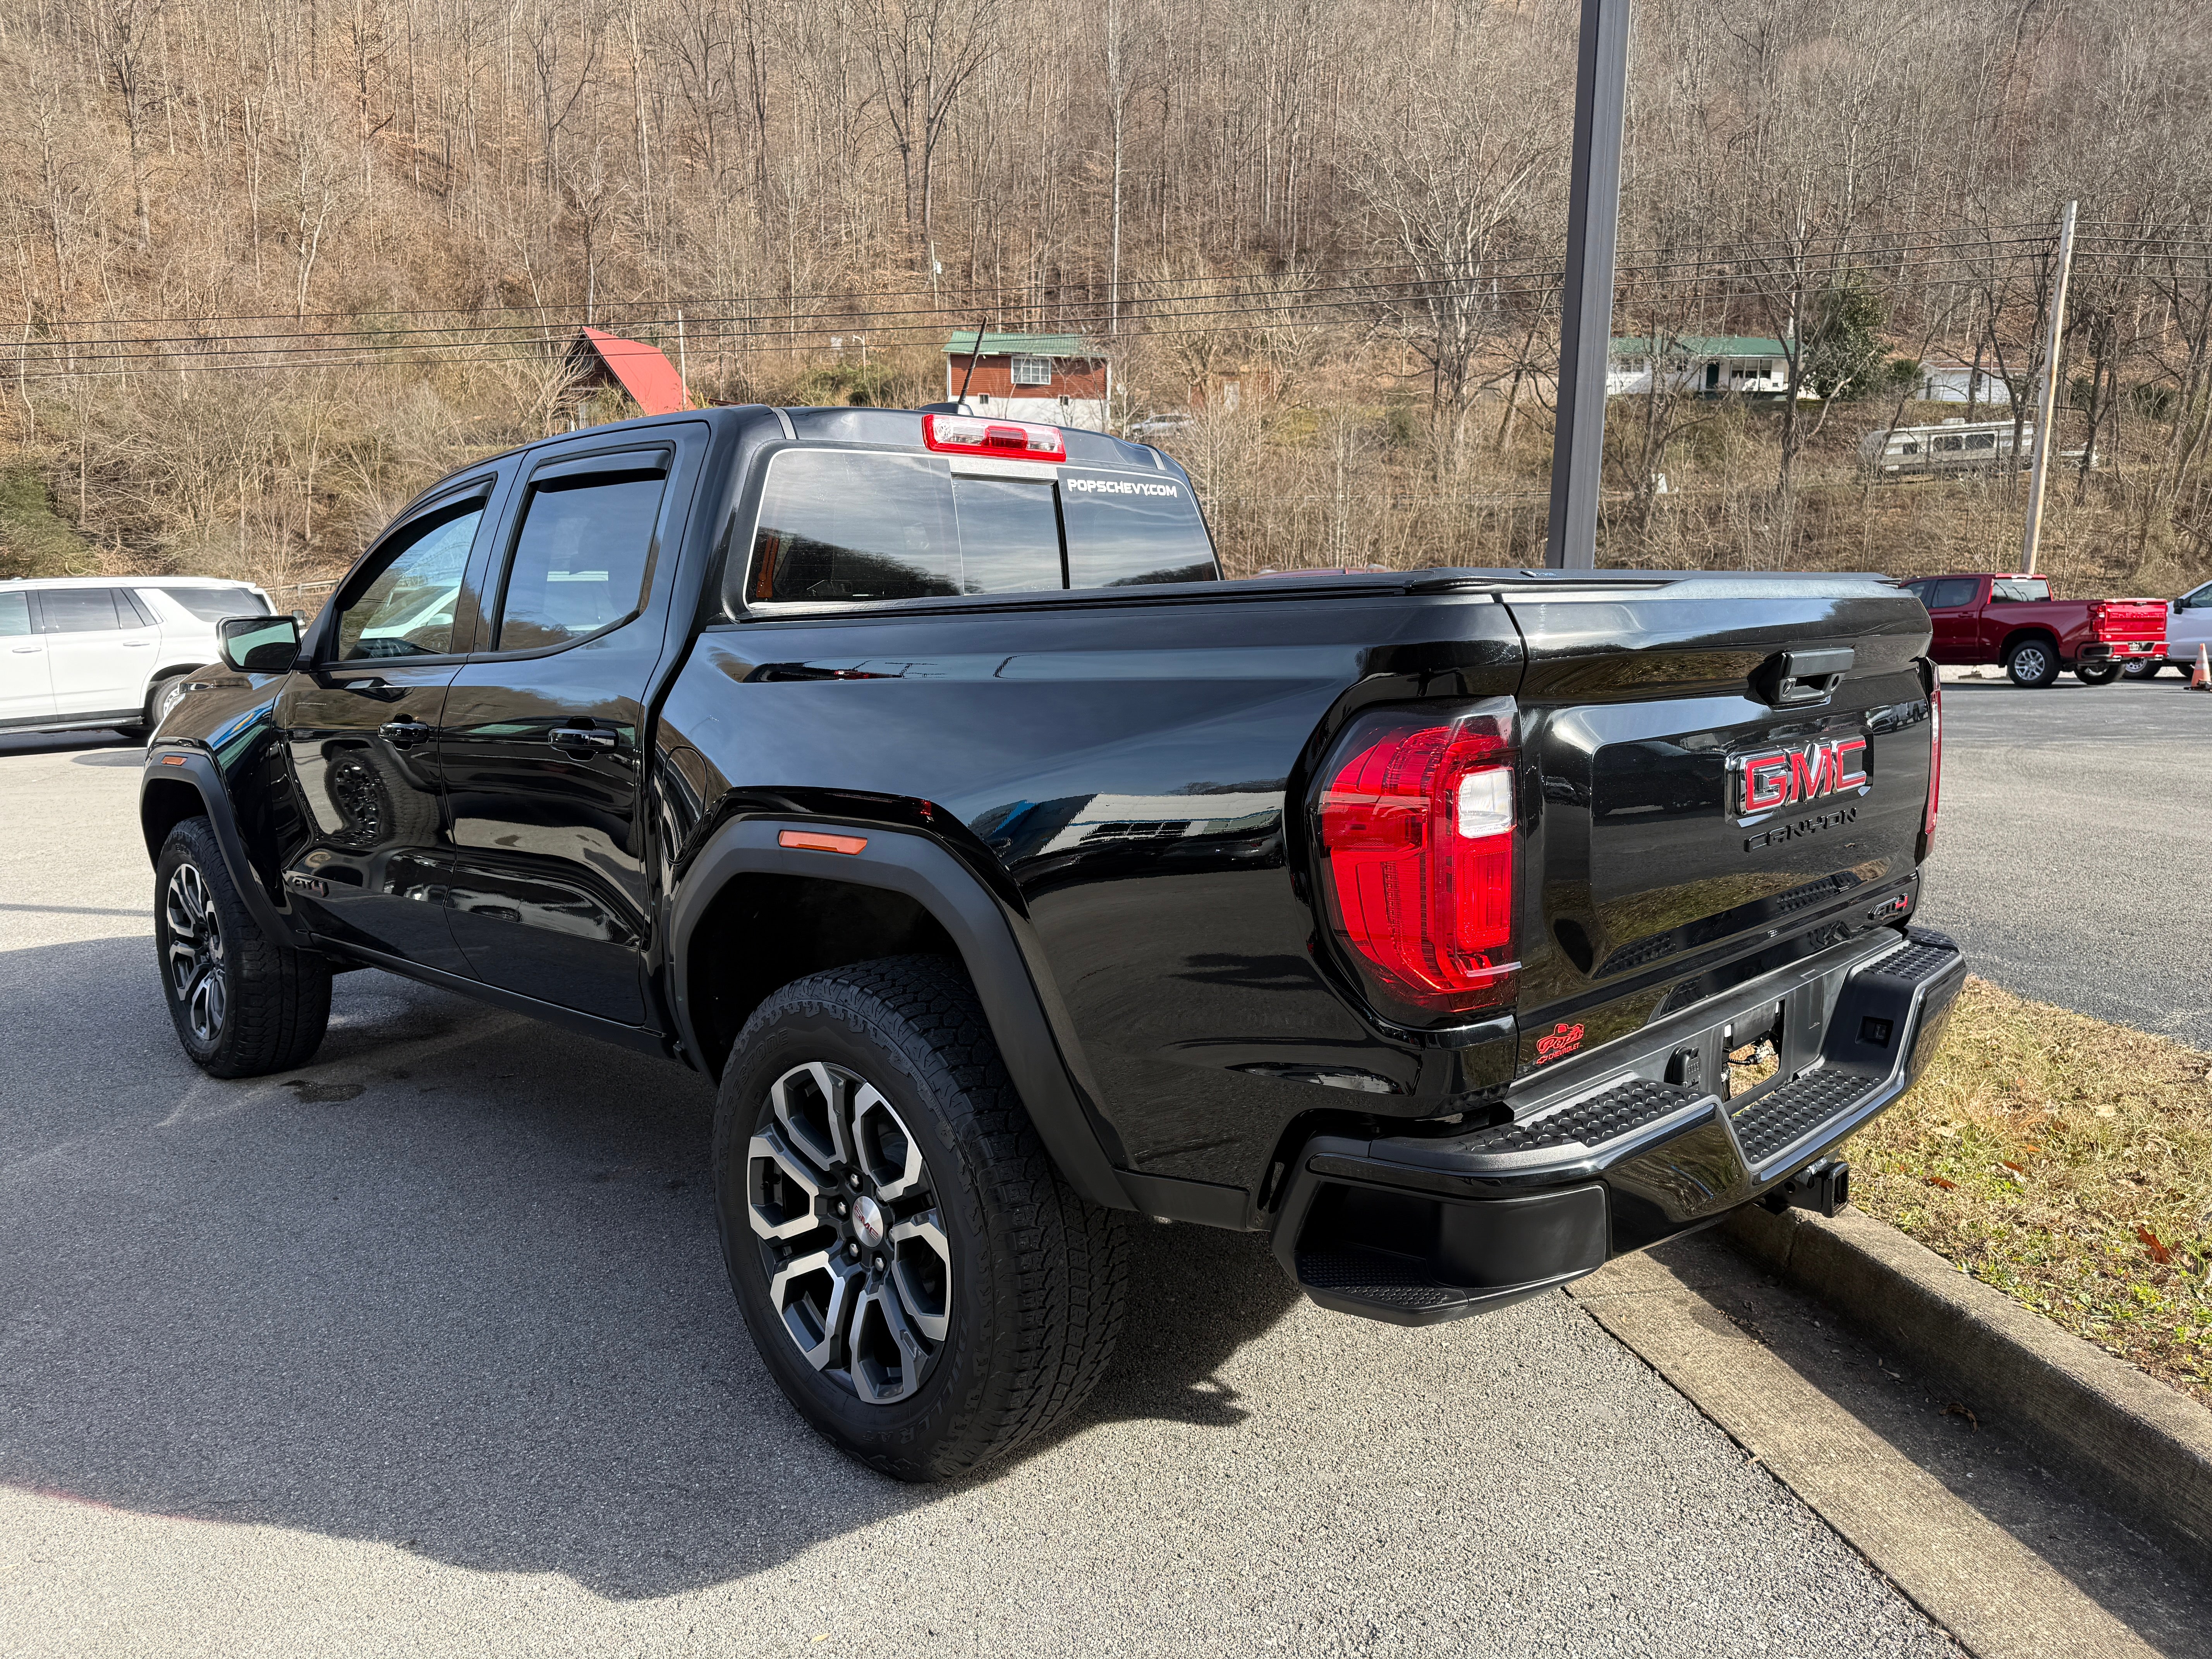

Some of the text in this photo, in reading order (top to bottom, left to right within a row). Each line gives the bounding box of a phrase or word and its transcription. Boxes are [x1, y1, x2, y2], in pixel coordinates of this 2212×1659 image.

[1067, 479, 1177, 498] POPSCHEVY.COM
[1740, 735, 1867, 815] GMC
[1743, 807, 1857, 852] CANYON
[1867, 893, 1908, 919] AT4
[1548, 1042, 1580, 1060] CHEVROLET
[854, 1204, 879, 1240] GMC
